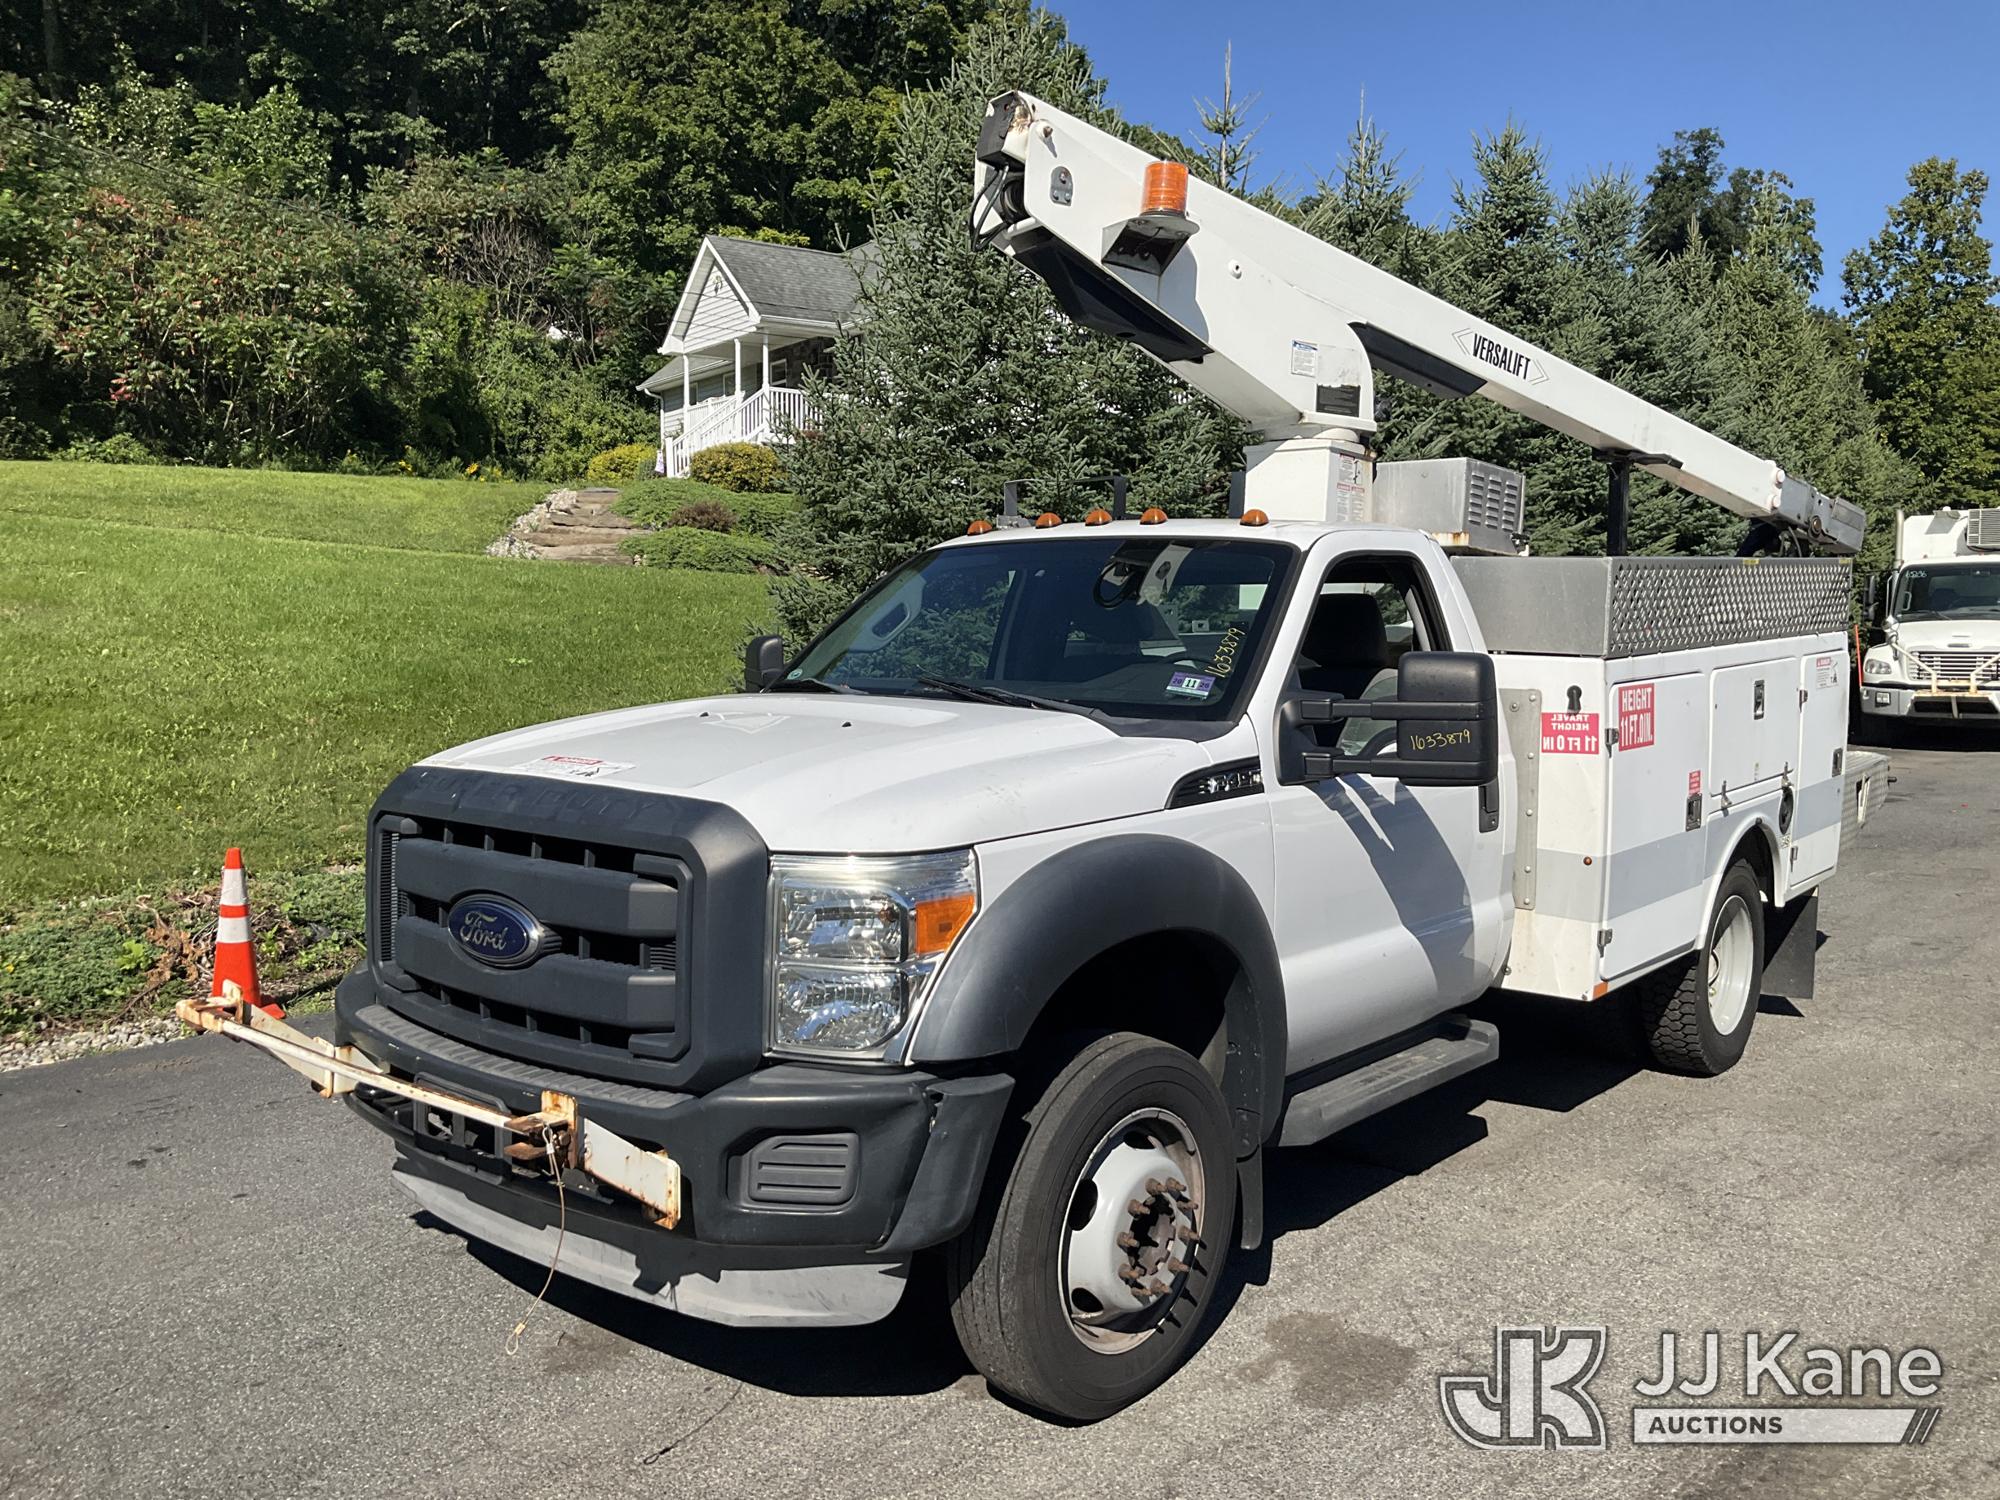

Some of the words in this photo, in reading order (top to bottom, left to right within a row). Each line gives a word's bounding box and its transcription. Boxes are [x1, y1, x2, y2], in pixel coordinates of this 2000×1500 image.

[1473, 333, 1531, 380] VERSALIFT
[1204, 627, 1246, 678] 1633879
[1185, 679, 1197, 688] 11
[1622, 687, 1652, 712] HEIGHT
[1410, 728, 1471, 750] 1633879
[460, 911, 508, 951] Ford
